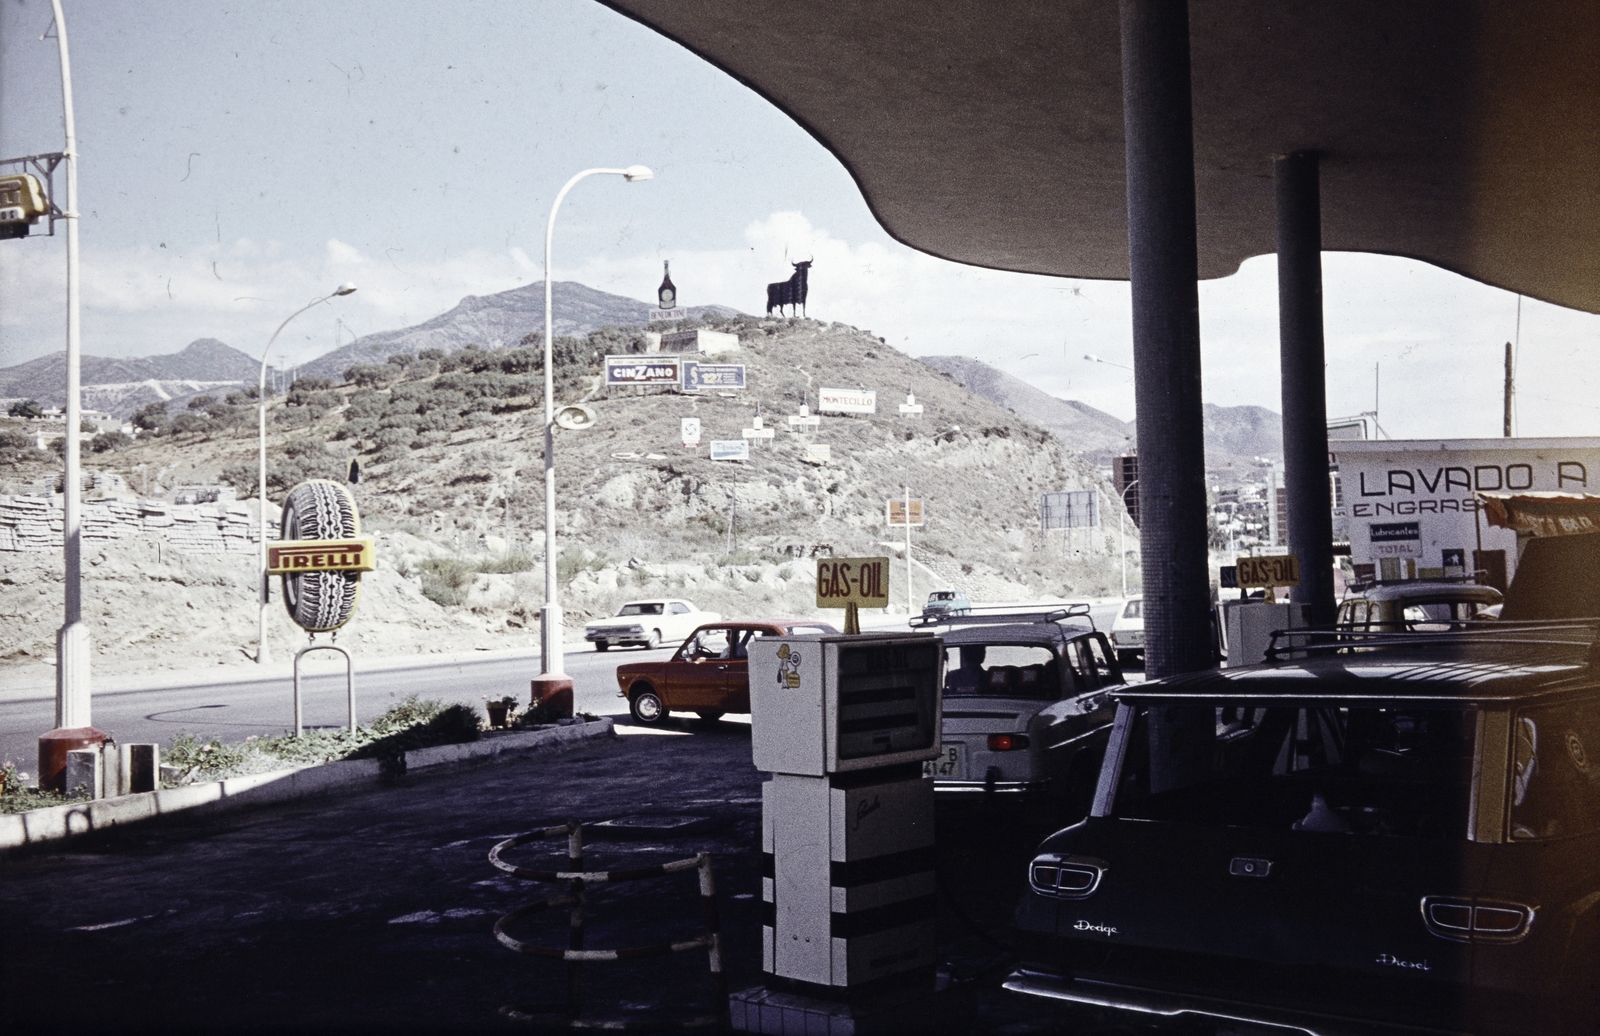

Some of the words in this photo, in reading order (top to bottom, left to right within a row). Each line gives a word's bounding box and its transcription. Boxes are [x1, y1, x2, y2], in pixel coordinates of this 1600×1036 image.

[613, 365, 674, 380] CINZANO
[823, 396, 873, 406] MONTECILLO
[1360, 463, 1533, 497] LAVADO
[1558, 461, 1588, 489] A
[1353, 499, 1476, 517] ENGRAS
[1370, 526, 1420, 537] Lubricantes
[269, 544, 364, 569] PIRELLI
[1378, 544, 1414, 554] TOTAL
[818, 562, 886, 598] GAS-OIL
[1240, 558, 1298, 585] GAS-OIL
[923, 761, 956, 776] 4147
[1073, 919, 1121, 937] Dodge
[1375, 953, 1432, 971] Diesel
